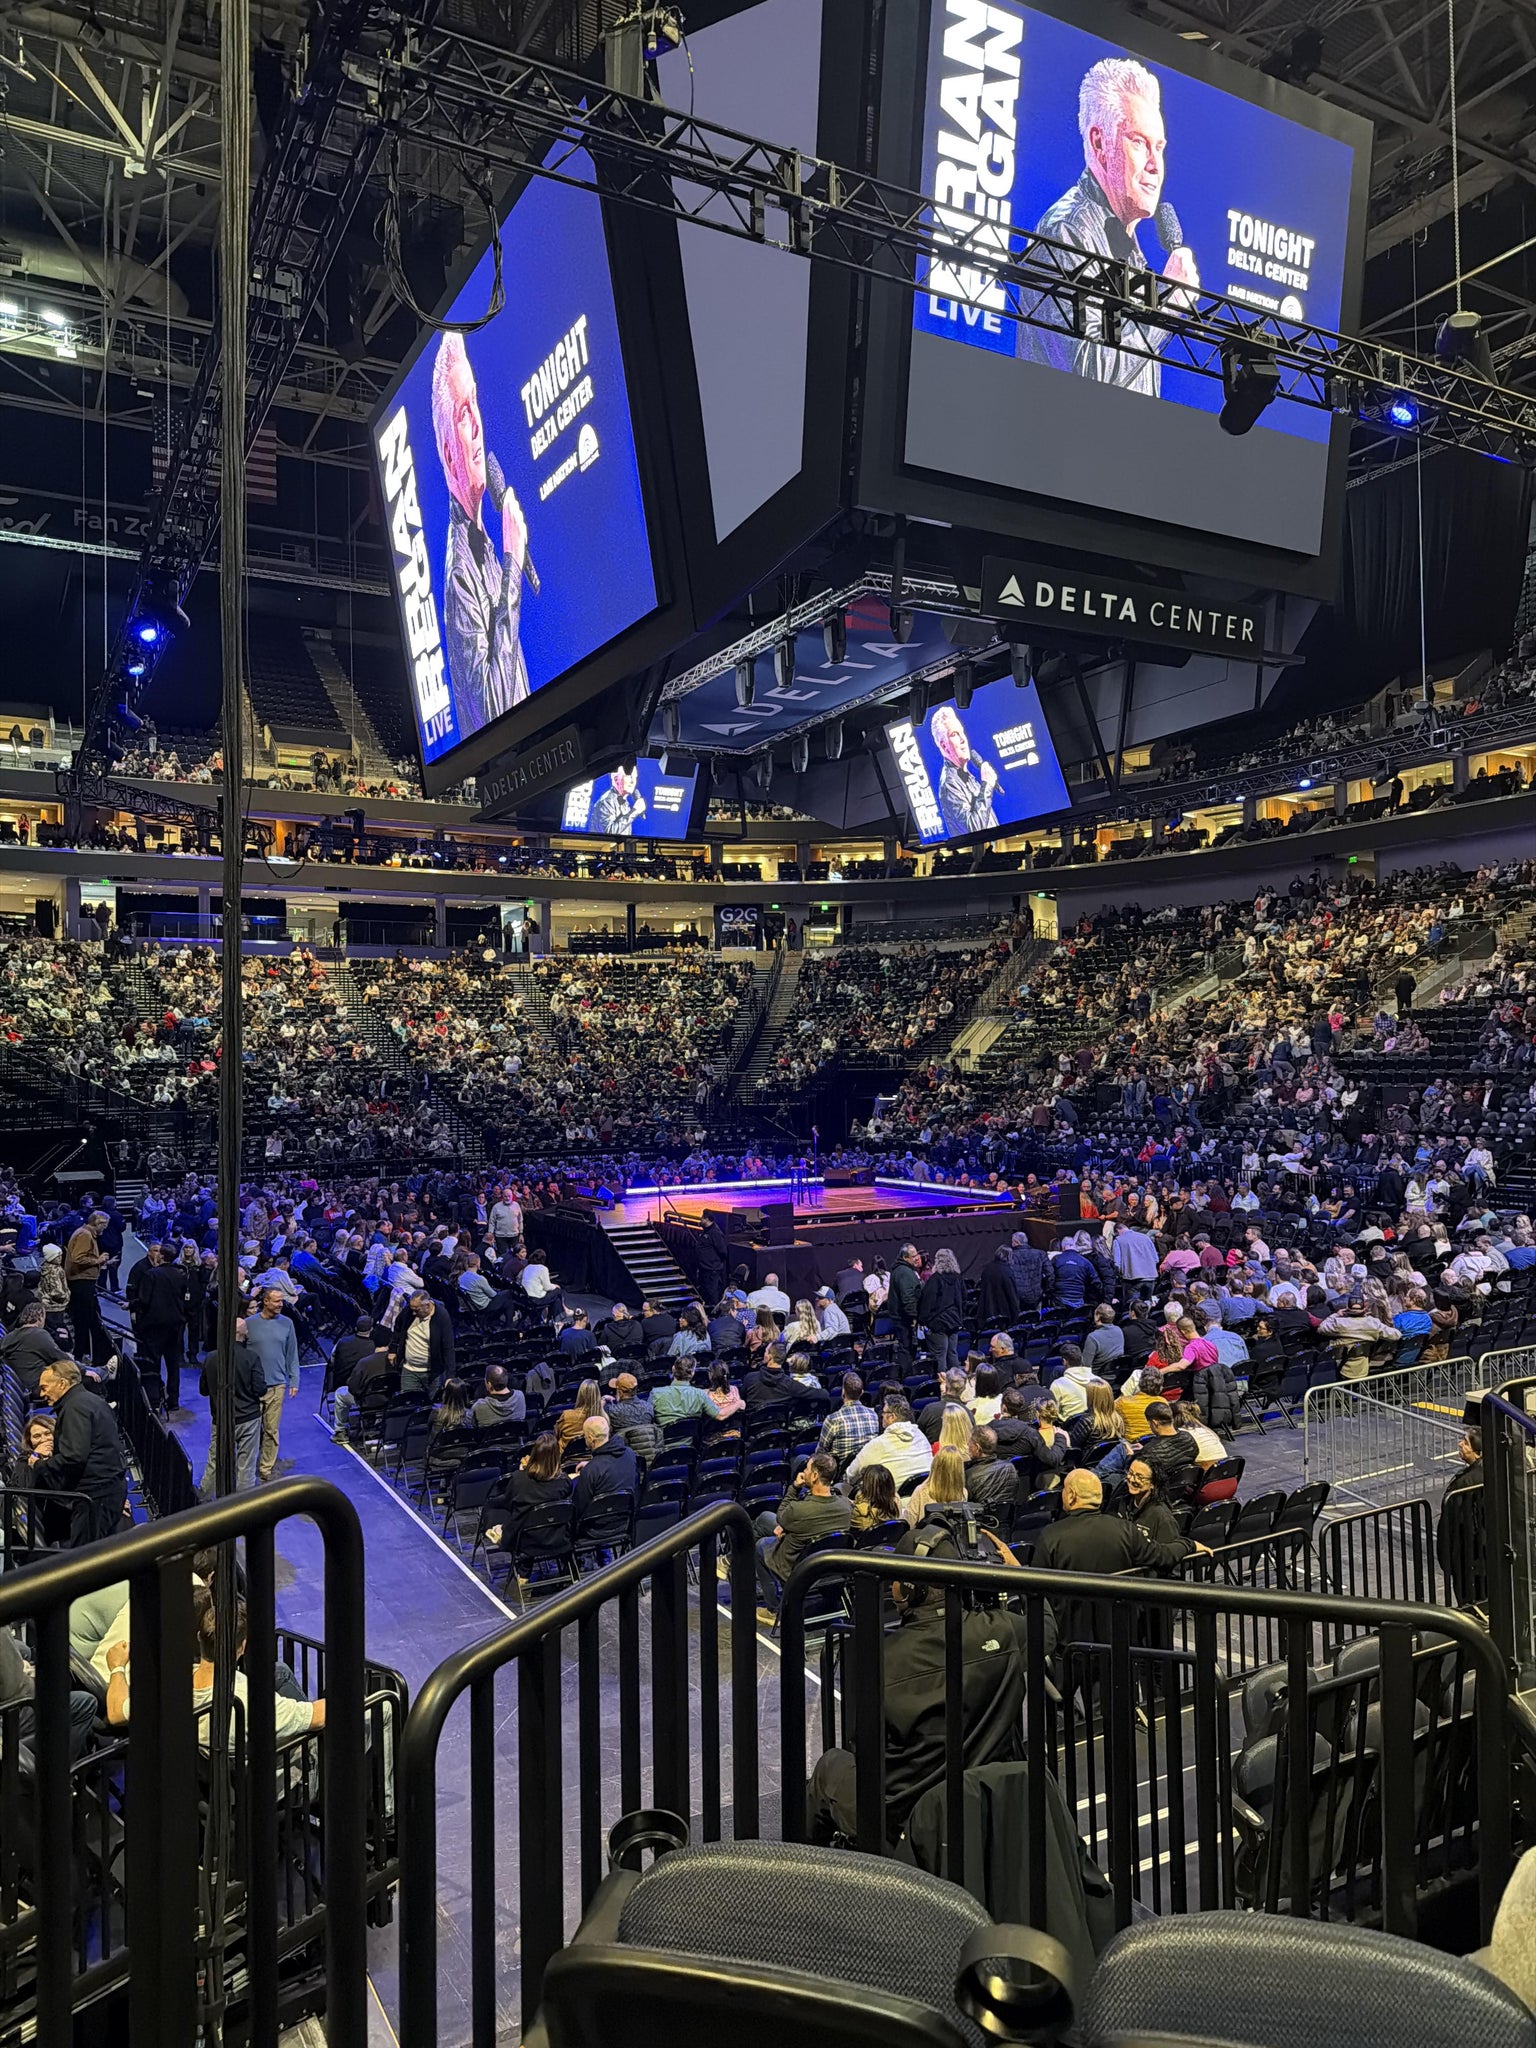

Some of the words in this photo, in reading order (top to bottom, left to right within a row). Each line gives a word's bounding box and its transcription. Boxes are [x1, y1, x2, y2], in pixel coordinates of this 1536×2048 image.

[929, 0, 988, 301] BRIAN
[969, 5, 1024, 311] REGAN
[1227, 209, 1315, 269] TONIGHT
[1227, 247, 1263, 276] DELTA
[1264, 261, 1309, 291] CENTER
[929, 294, 1002, 334] LIVE
[520, 314, 588, 428] TONIGHT
[530, 413, 559, 461] DELTA
[556, 375, 594, 432] CENTER
[73, 508, 119, 533] Fan
[124, 516, 152, 538] Zo
[378, 405, 436, 723] BRIAN
[1035, 581, 1137, 623] DELTA
[1150, 602, 1254, 642] CENTER
[731, 641, 925, 717] DELTA
[424, 705, 453, 747] LIVE
[491, 767, 528, 801] DELTA
[528, 740, 575, 780] CENTER
[922, 824, 944, 838] LIVE
[720, 907, 758, 922] G2G
